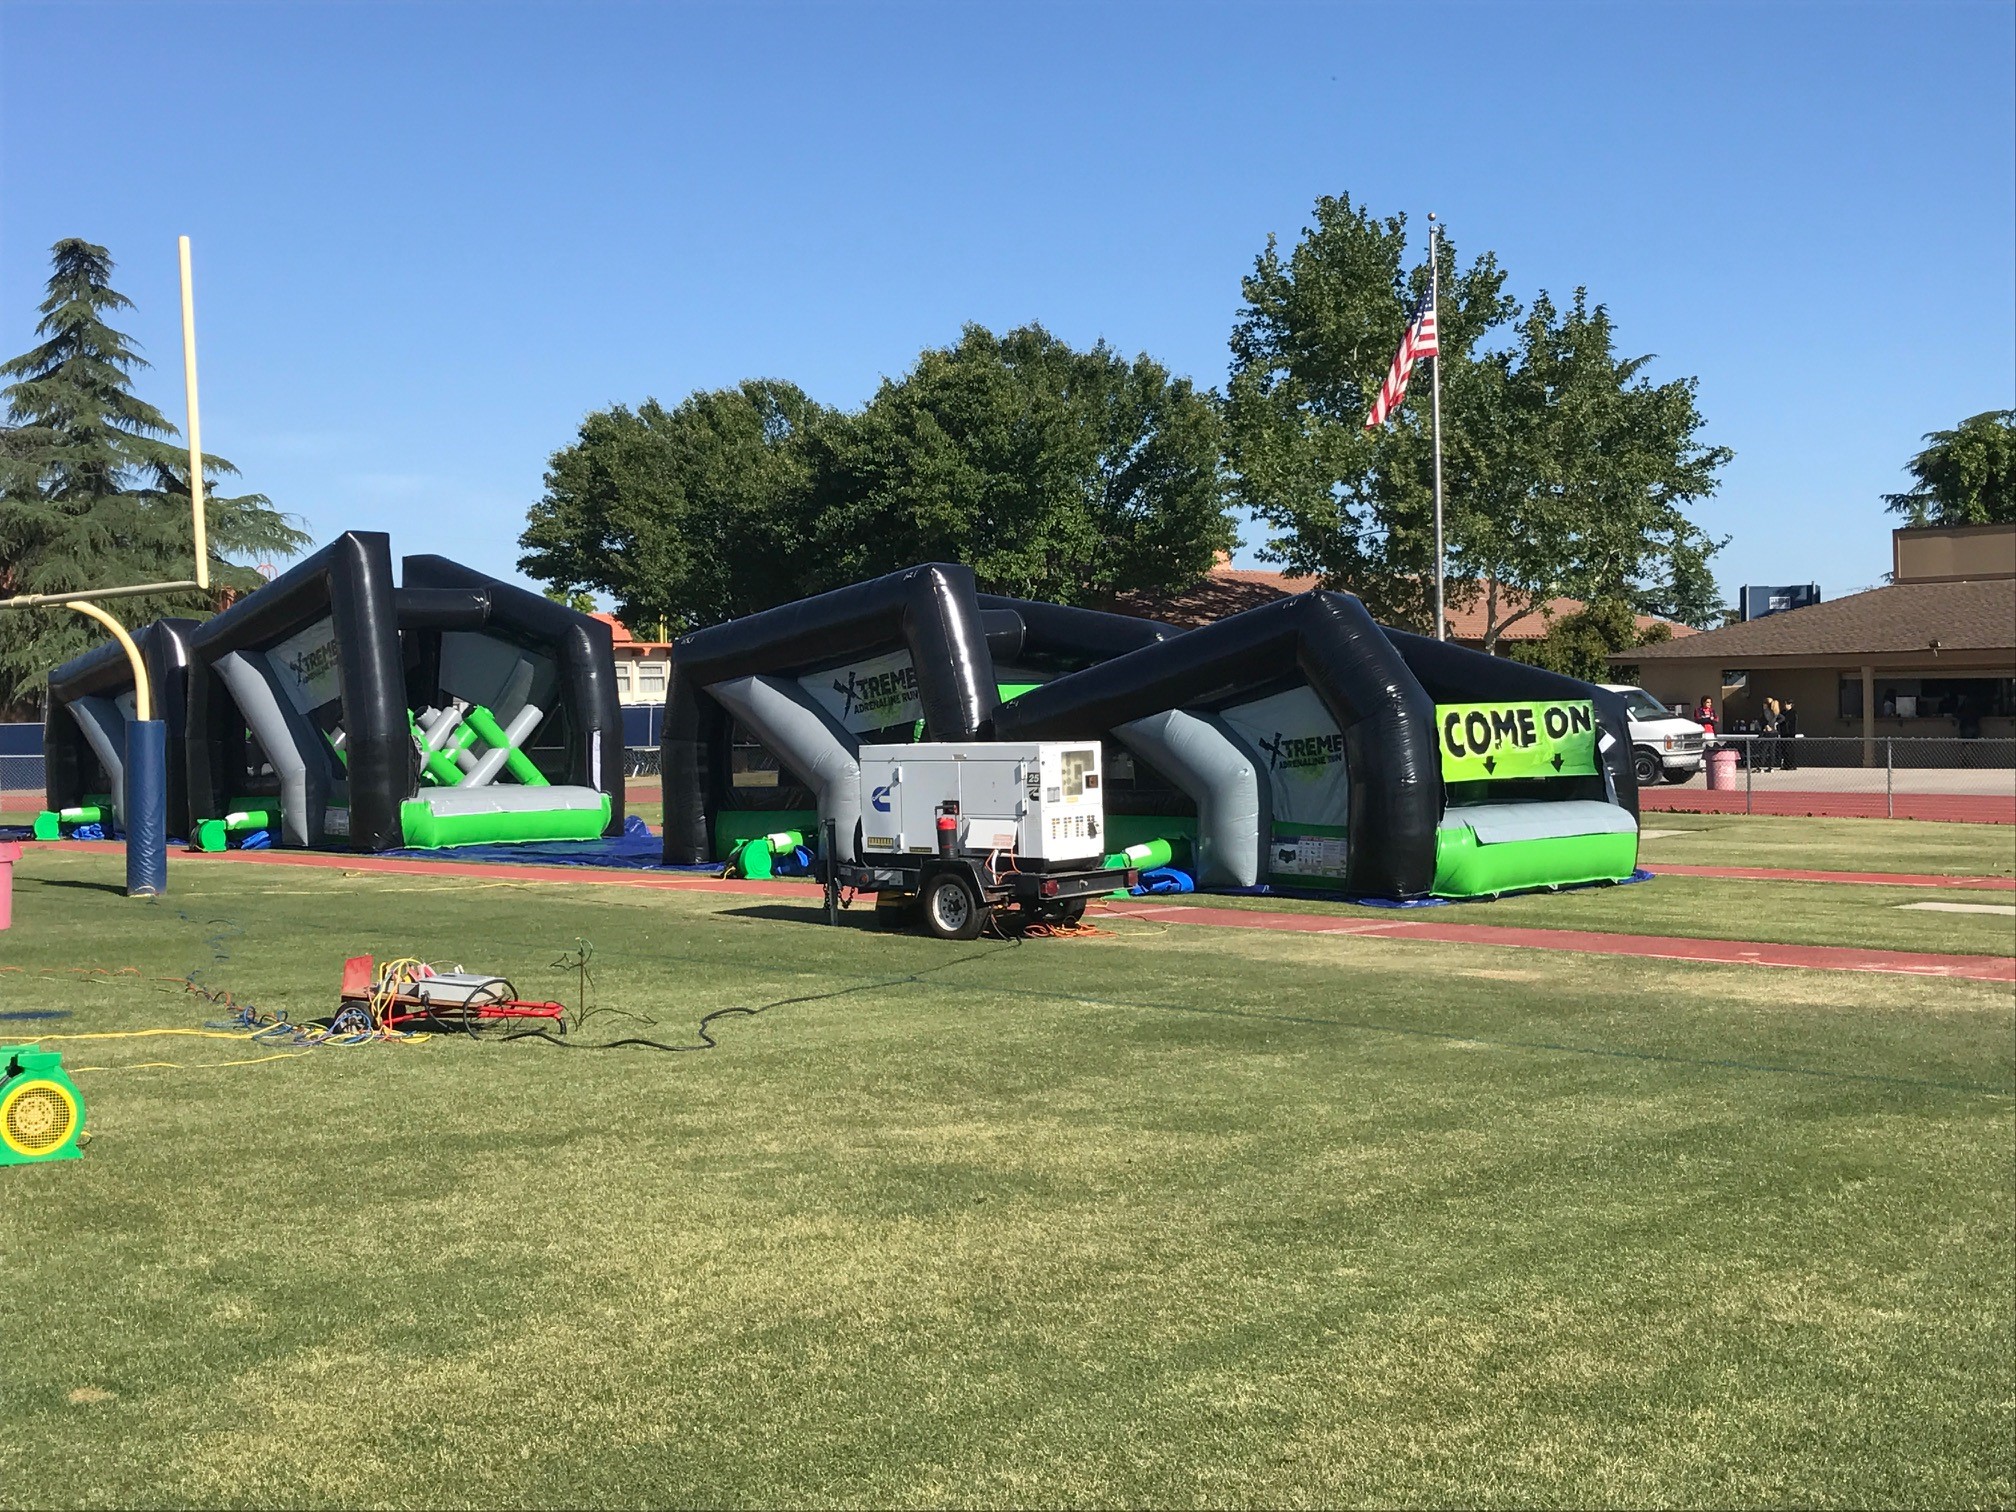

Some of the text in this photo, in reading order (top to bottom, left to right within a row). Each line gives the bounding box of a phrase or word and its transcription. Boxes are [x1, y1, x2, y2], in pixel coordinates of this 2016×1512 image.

[833, 667, 918, 721] XTREME
[854, 690, 919, 714] ADRENALINE RUN
[1444, 705, 1592, 758] COME ON
[1259, 732, 1342, 774] XTREME
[1028, 774, 1039, 783] 25
